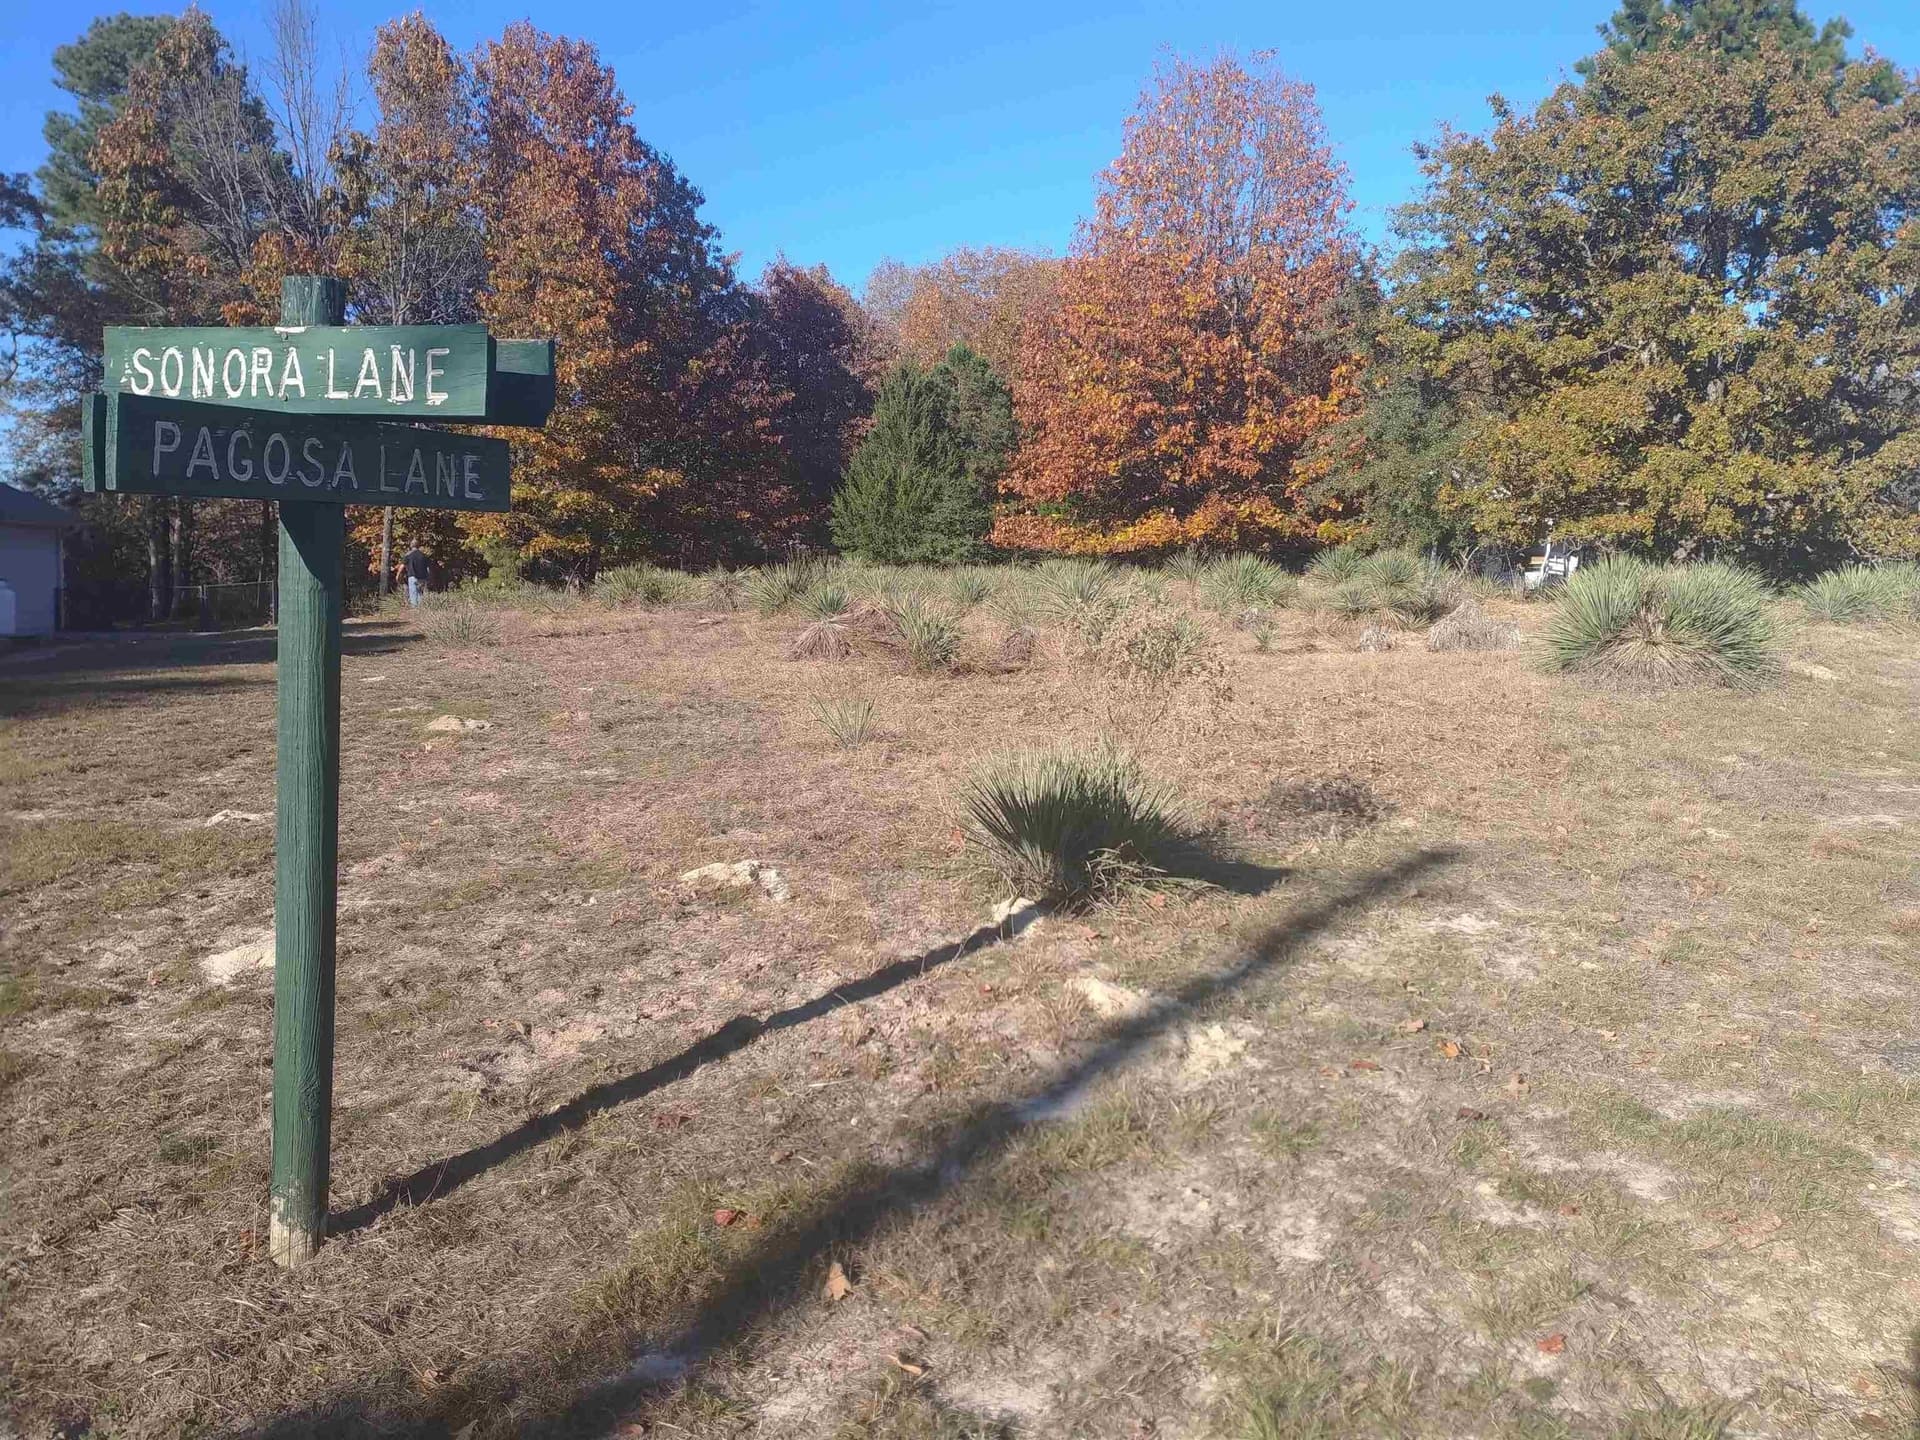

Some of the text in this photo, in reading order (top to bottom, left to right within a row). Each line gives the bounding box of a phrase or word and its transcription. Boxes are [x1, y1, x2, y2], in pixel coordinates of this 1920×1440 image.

[130, 345, 450, 403] SONORA LANE
[152, 420, 484, 499] PAGOSA LANE
